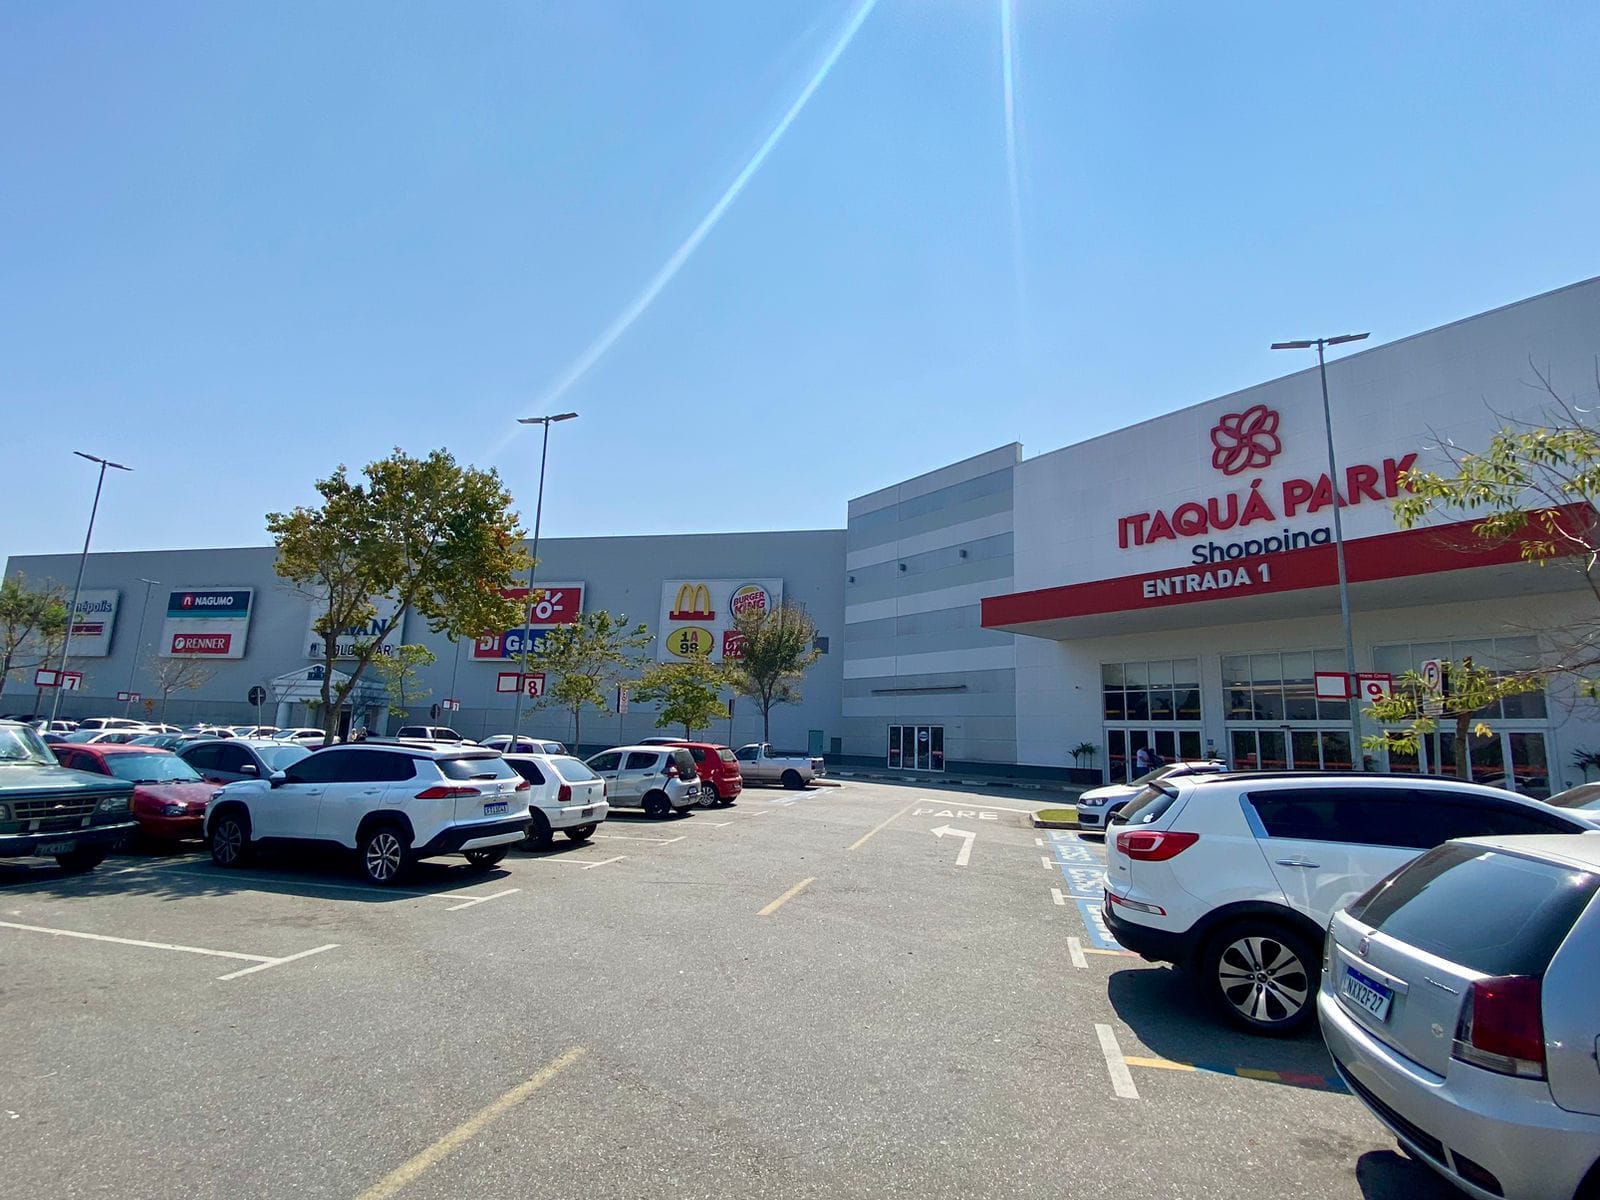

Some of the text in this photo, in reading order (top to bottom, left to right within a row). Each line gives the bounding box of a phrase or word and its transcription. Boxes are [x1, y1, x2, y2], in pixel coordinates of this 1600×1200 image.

[1118, 452, 1420, 549] ITAQUÁ PARK
[1142, 562, 1271, 599] ENTRADA 1
[194, 596, 234, 606] NAGUMO
[733, 591, 765, 607] BURGER
[734, 599, 766, 615] KING
[185, 638, 225, 649] RENNER
[480, 635, 500, 651] Di
[680, 642, 699, 654] 99
[68, 678, 77, 690] 7
[528, 680, 538, 695] 8
[1366, 682, 1383, 702] 9
[911, 807, 999, 821] PARE
[1346, 977, 1384, 1014] NXX2F27
